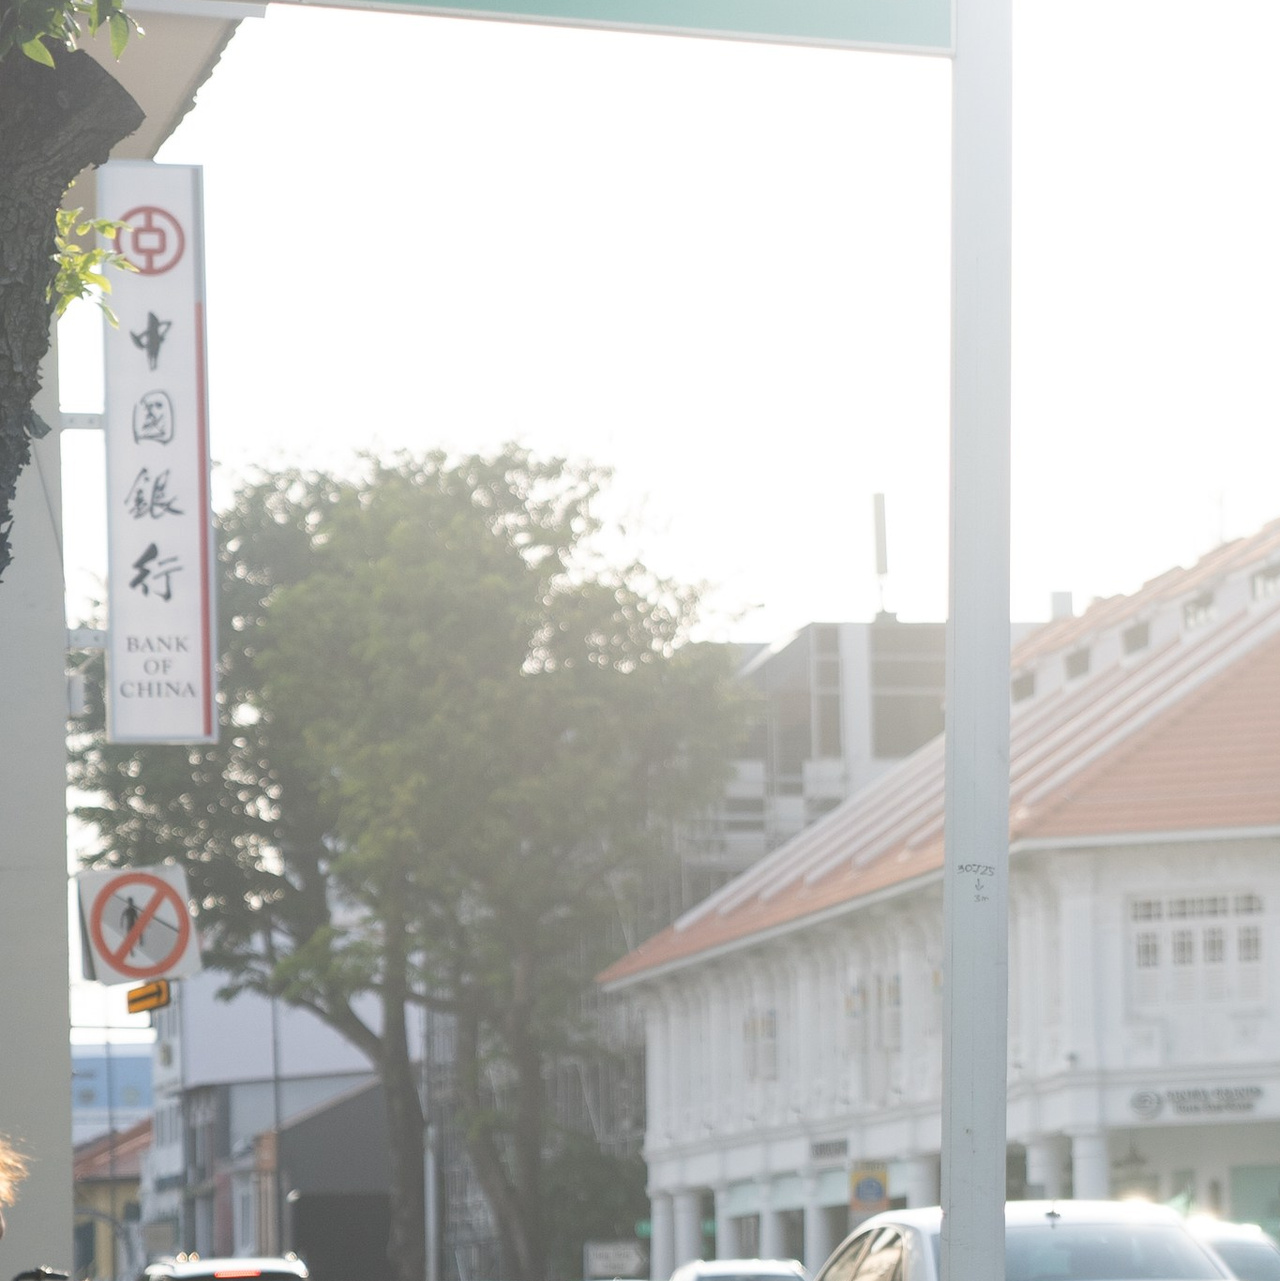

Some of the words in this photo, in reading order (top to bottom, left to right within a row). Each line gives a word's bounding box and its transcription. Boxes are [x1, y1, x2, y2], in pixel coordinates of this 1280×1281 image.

[126, 635, 189, 653] BANK
[143, 658, 173, 676] OF
[119, 681, 197, 699] CHINA
